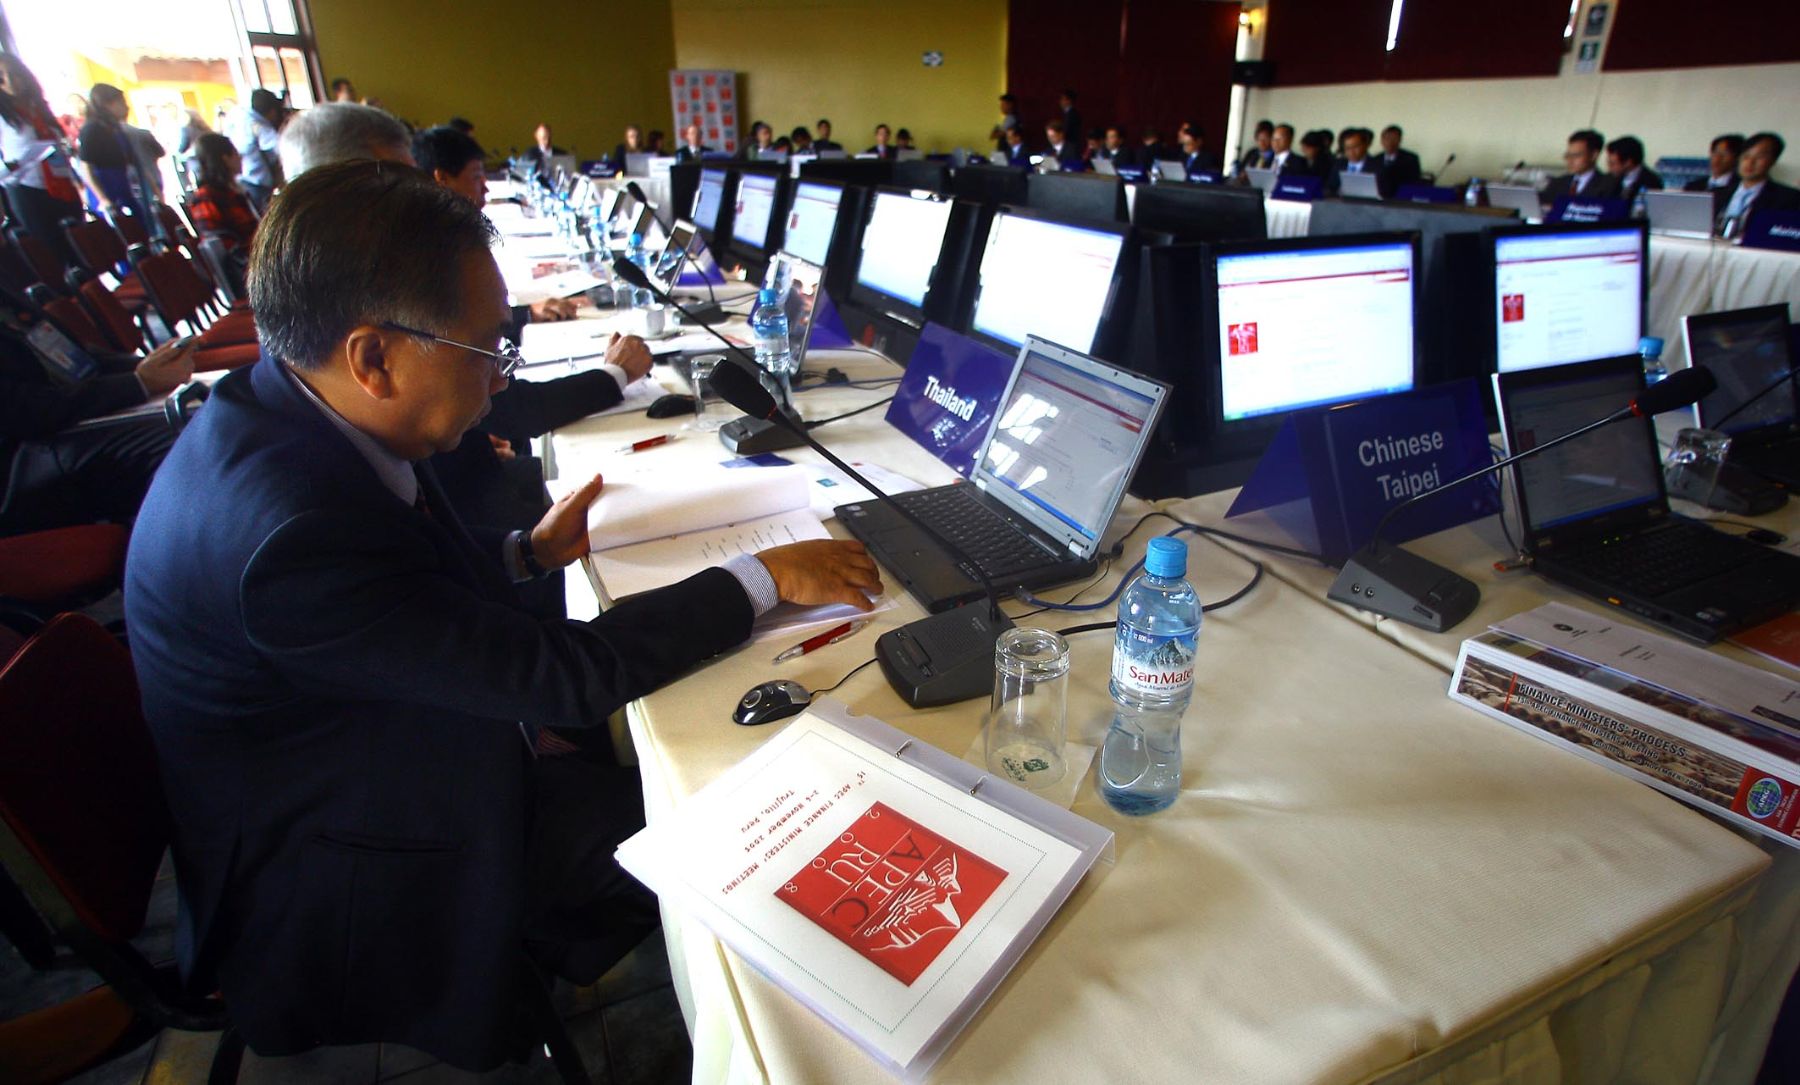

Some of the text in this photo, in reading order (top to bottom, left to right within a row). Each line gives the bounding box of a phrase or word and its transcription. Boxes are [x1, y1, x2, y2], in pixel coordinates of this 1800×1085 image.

[924, 375, 977, 421] Thailand
[1358, 431, 1443, 467] Chinese
[1376, 463, 1441, 500] Taipei
[1129, 665, 1158, 684] San
[1519, 683, 1564, 708] FINANCE
[1631, 728, 1686, 757] PROCESS
[834, 783, 851, 800] APEC
[768, 802, 805, 835] November
[804, 800, 834, 827] FINANCE
[722, 862, 760, 895] MEETINGS
